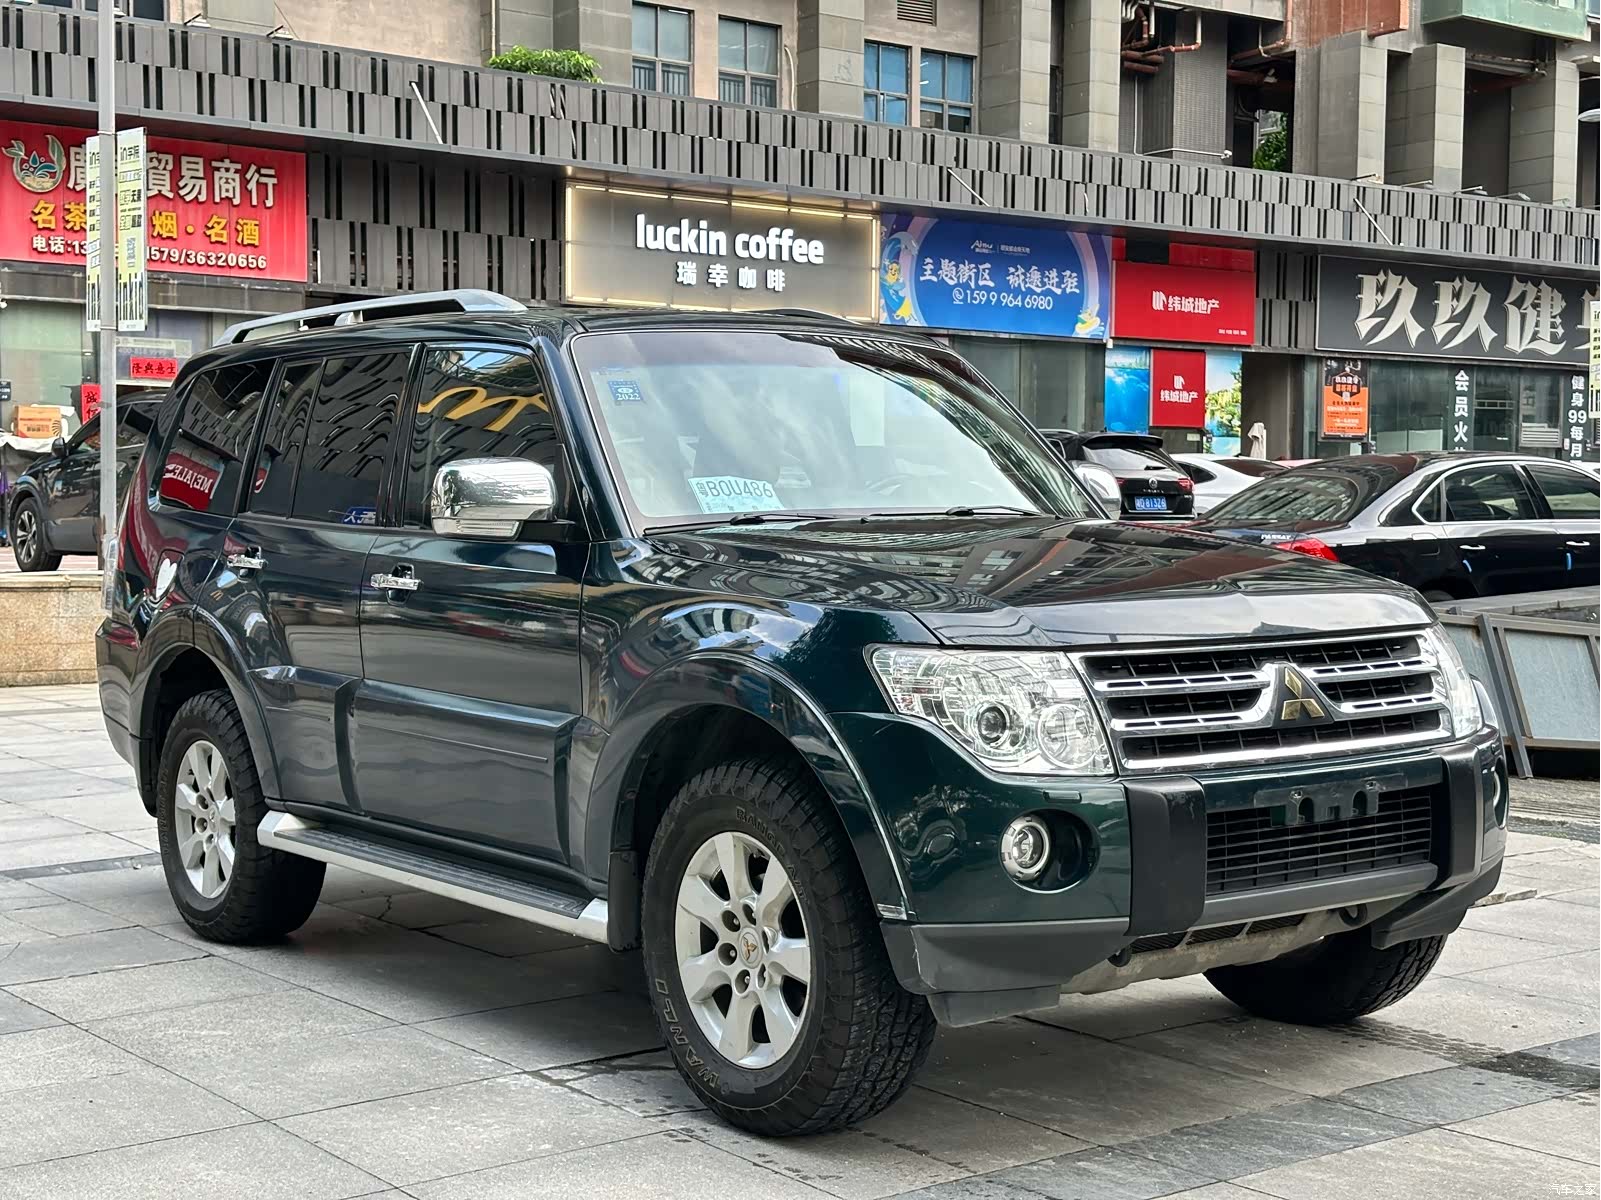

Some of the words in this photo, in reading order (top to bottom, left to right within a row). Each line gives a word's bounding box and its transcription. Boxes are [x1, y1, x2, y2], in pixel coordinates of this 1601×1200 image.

[636, 213, 727, 256] luckin
[734, 227, 824, 265] coffee
[676, 260, 786, 292] 瑞幸咖啡
[919, 257, 995, 288] 主题街区
[1006, 264, 1080, 295] 诚邀进驻
[1024, 294, 1053, 310] 6980
[1167, 296, 1220, 314] 纬城地产
[1160, 390, 1199, 403] 纬城地产
[1454, 369, 1470, 451] 会员火
